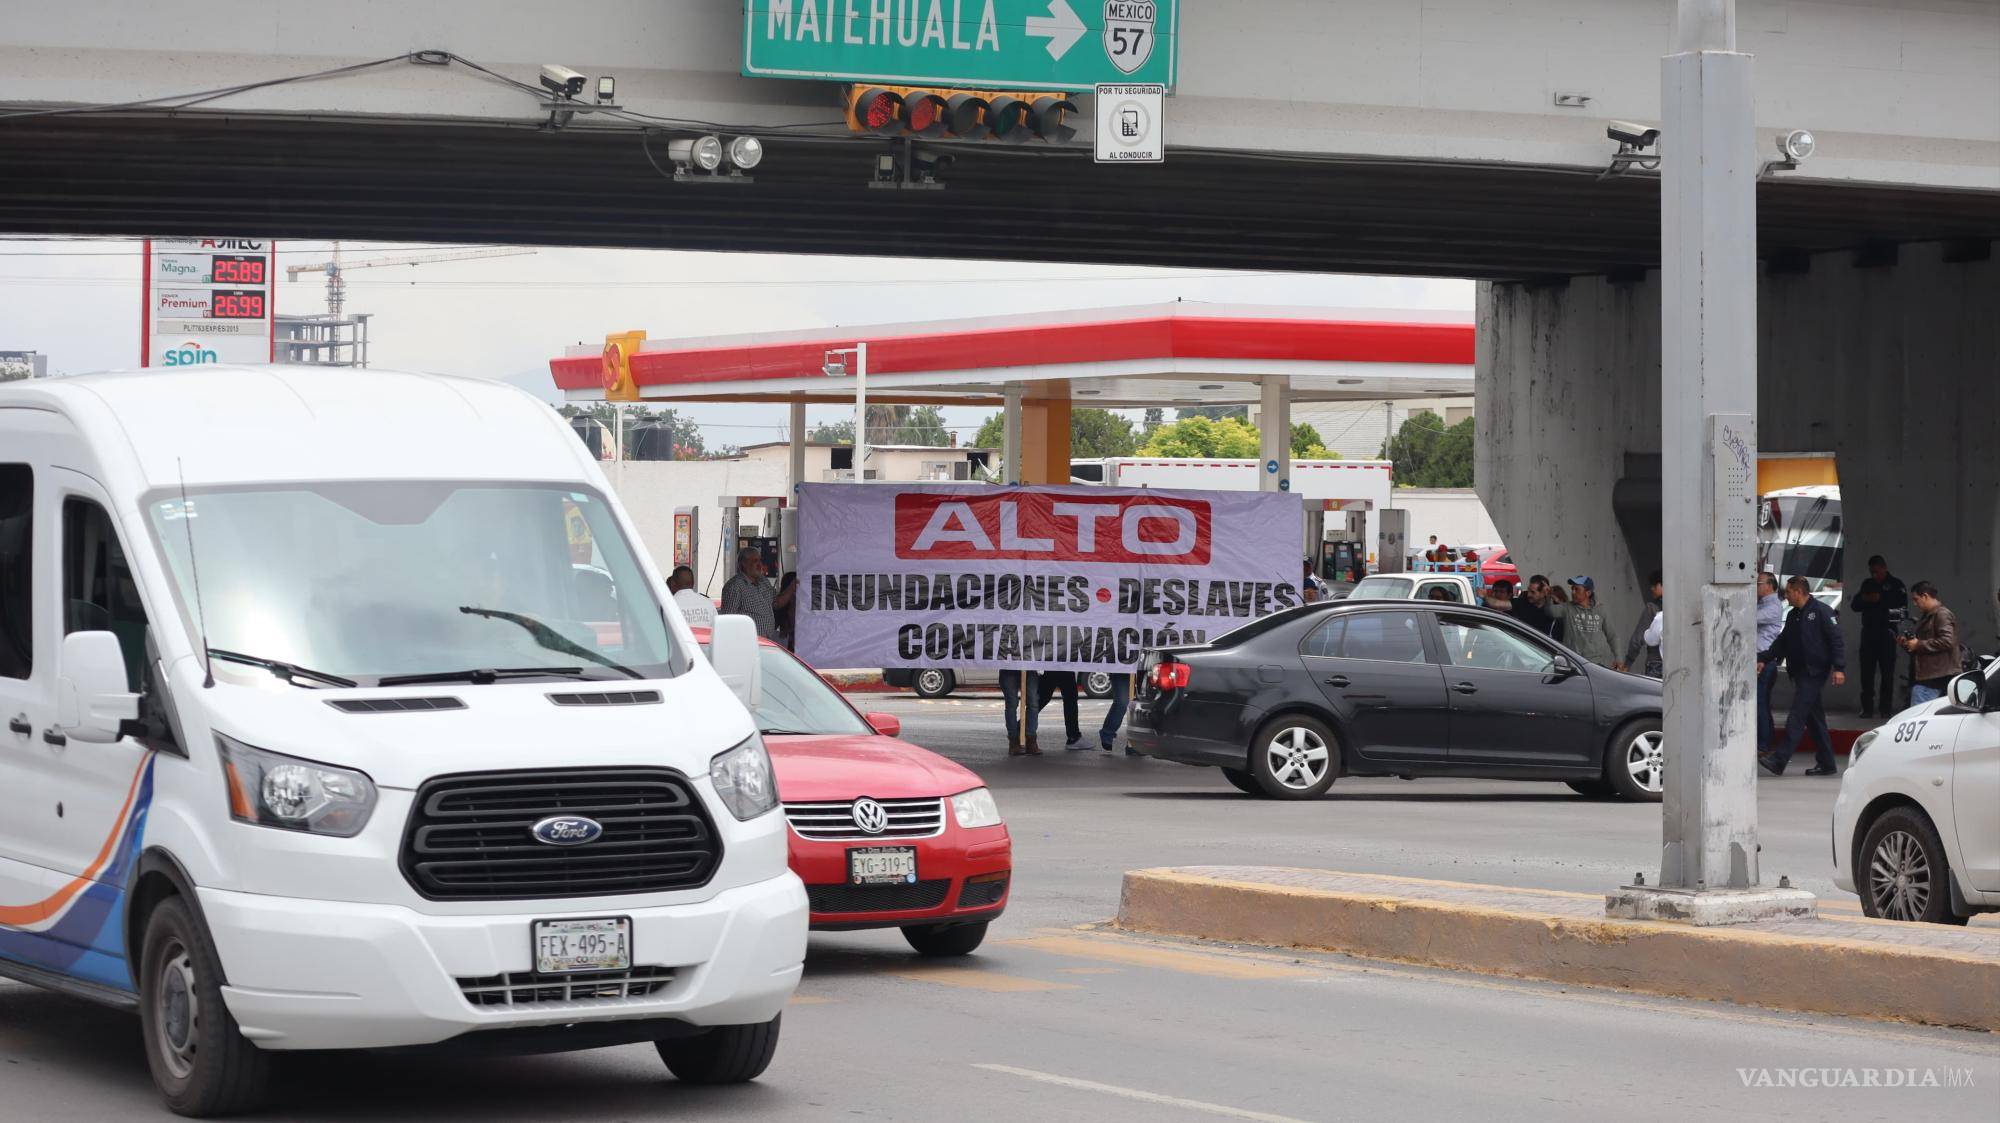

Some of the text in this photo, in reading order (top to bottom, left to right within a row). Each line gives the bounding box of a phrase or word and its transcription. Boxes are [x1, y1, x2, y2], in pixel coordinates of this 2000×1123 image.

[1108, 3, 1152, 20] MEXICO
[767, 0, 999, 51] MATEHUALA
[1112, 28, 1145, 56] 57
[1099, 87, 1161, 95] POR TU SEGURIDAD
[1119, 151, 1153, 159] CONDUCIR
[161, 260, 263, 283] Magna 25.89
[161, 296, 263, 318] Premium 26.99
[910, 502, 1198, 555] ALTO
[810, 573, 1297, 617] INUNDACIONES DESLAVES
[1894, 721, 1928, 743] 897
[551, 821, 588, 839] Ford
[853, 856, 914, 873] EYG-319-C
[540, 932, 626, 958] FEX-495-A
